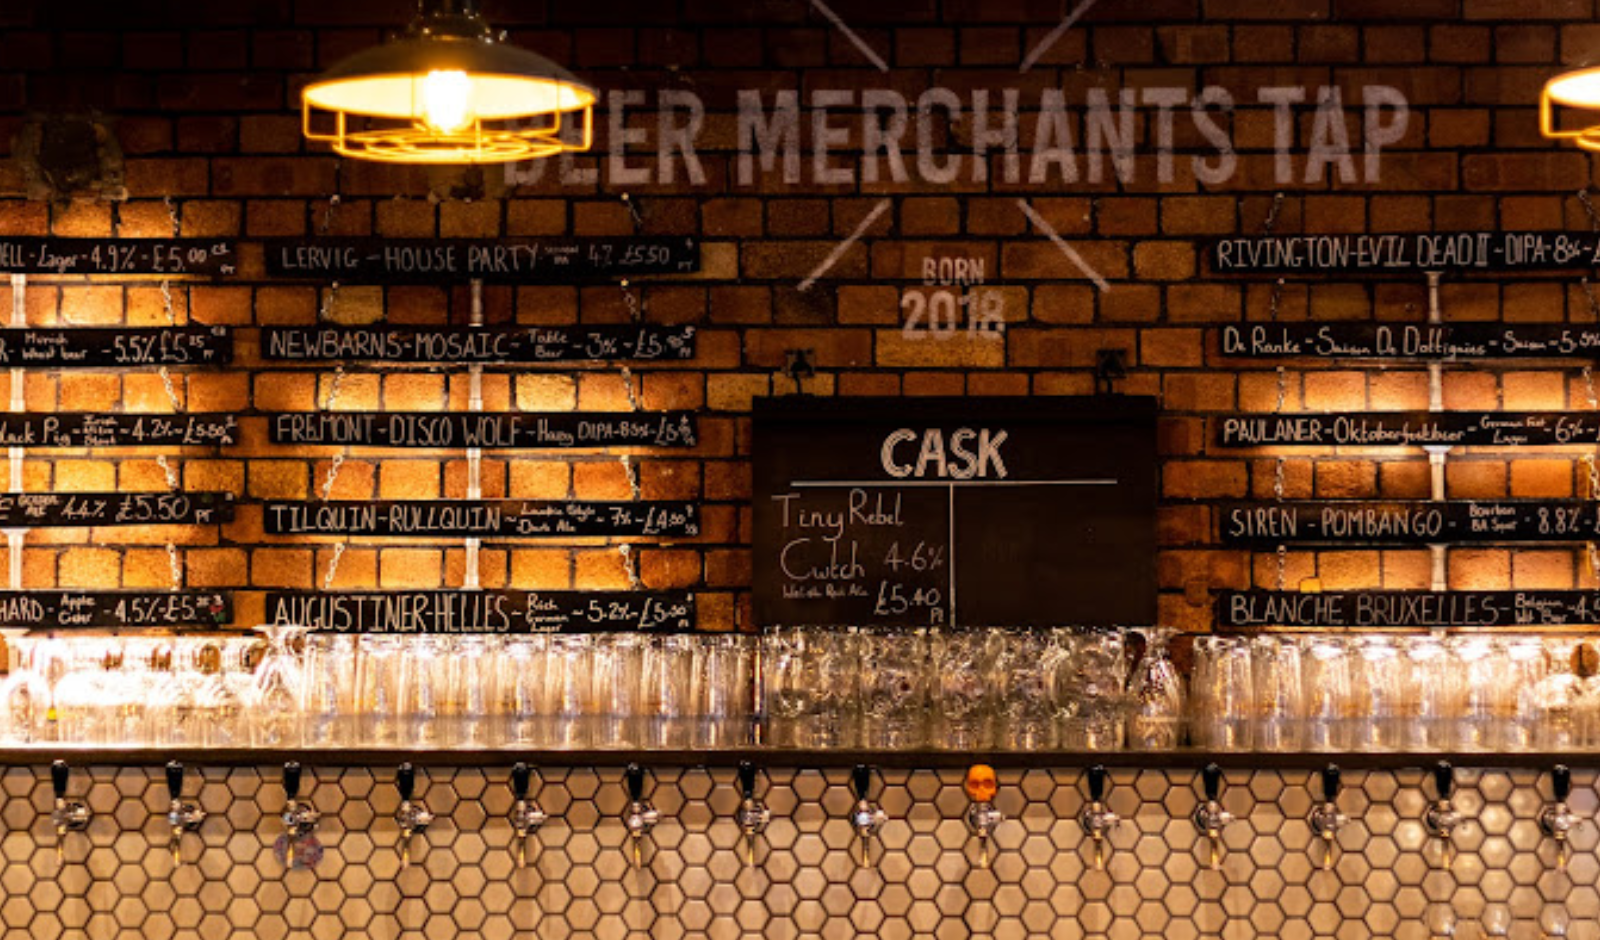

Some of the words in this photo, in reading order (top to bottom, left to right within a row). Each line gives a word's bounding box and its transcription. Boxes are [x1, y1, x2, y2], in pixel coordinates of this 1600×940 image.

[736, 84, 1239, 187] MERCHANTS
[1257, 84, 1410, 186] TAP
[37, 243, 79, 274] Lager
[281, 246, 359, 270] LERVIG
[384, 246, 457, 272] HOUSE
[468, 243, 538, 273] PARTY
[1416, 233, 1473, 267] DEAD
[922, 257, 985, 287] BORN
[900, 290, 1005, 341] 2018
[528, 328, 569, 344] Table
[461, 415, 522, 447] WOLF
[879, 427, 1009, 480] CASK
[115, 494, 190, 522] £5.50
[771, 493, 845, 541] Tiny
[848, 487, 904, 527] Rebel
[1229, 506, 1298, 538] SIREN
[1321, 505, 1443, 538] POMBANGO
[1537, 506, 1581, 535] 8.8%
[780, 535, 866, 581] Cwtch
[884, 541, 944, 573] 4.6%
[874, 580, 941, 616] £5.40
[1229, 594, 1344, 626] BLANCHE
[1355, 592, 1500, 626] BRUXELLES
